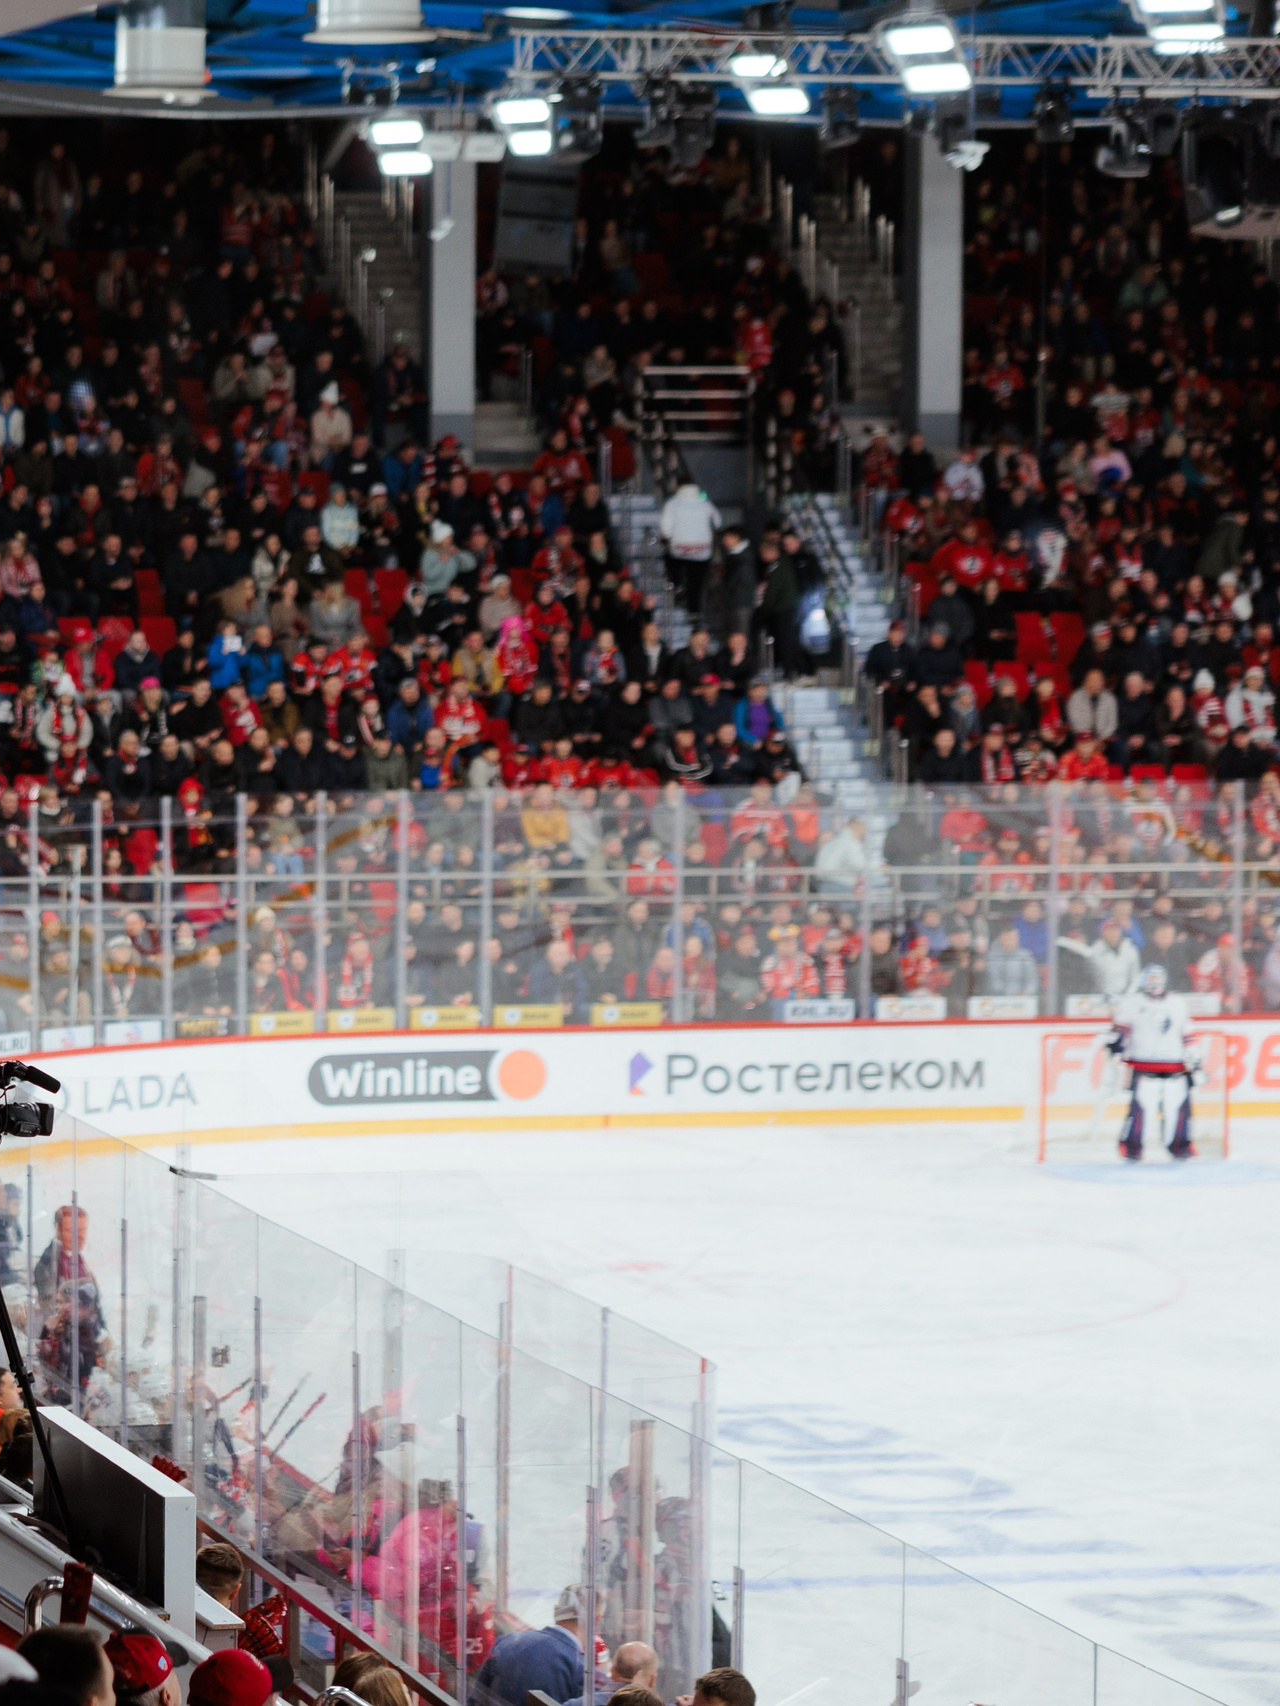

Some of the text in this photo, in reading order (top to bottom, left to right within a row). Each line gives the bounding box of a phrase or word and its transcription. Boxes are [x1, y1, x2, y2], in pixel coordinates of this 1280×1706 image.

[84, 1072, 199, 1115] LADA
[319, 1060, 481, 1099] Winline
[664, 1053, 985, 1095] Ростелеком
